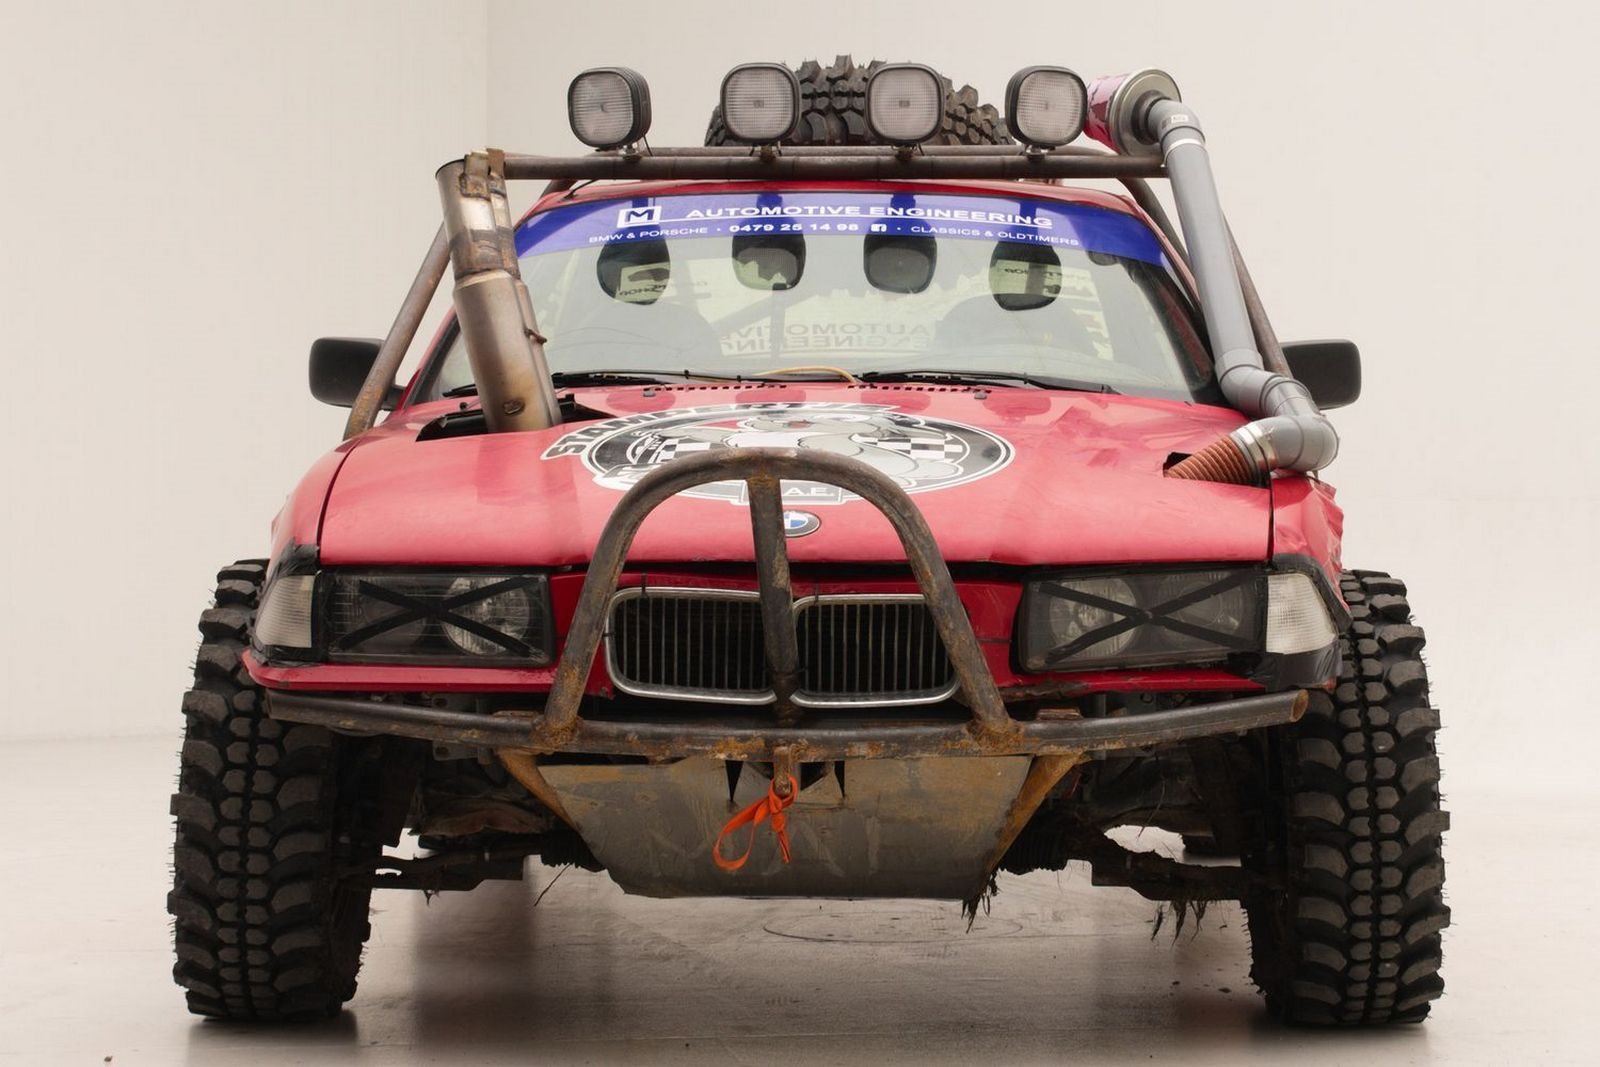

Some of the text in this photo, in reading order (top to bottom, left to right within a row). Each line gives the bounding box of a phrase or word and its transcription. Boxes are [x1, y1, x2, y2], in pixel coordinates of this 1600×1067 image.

[622, 208, 657, 224] M
[686, 206, 1053, 226] AUTOMOTIVE ENGINEERING
[589, 233, 622, 243] BMW
[639, 227, 708, 238] PORSCHE
[729, 224, 774, 233] 0479
[780, 223, 803, 231] 25
[809, 223, 831, 231] 14
[836, 223, 859, 231] 98
[911, 225, 980, 236] CLASSICS
[997, 231, 1080, 246] OLDTIMERS
